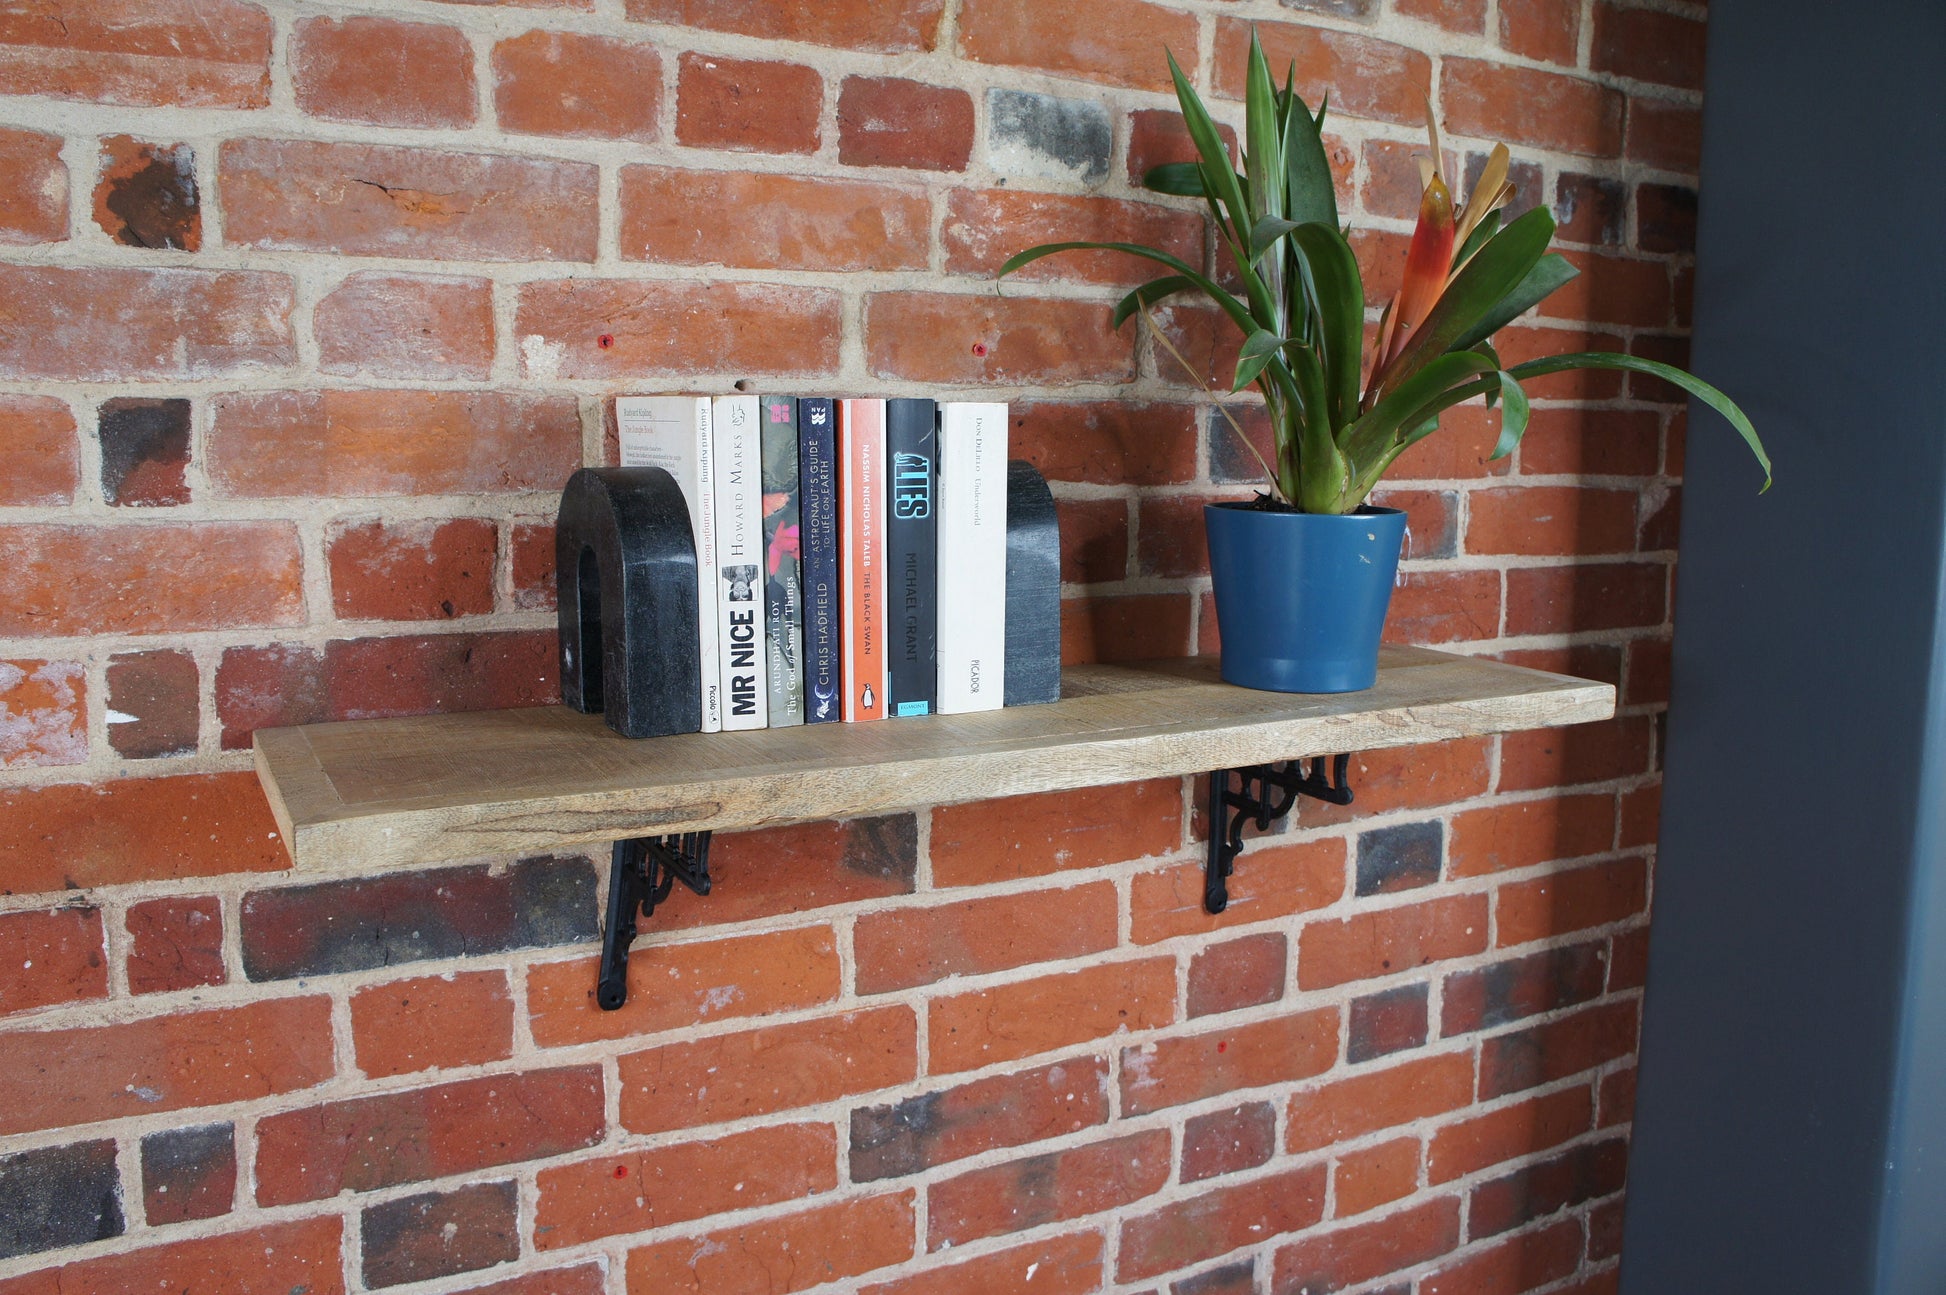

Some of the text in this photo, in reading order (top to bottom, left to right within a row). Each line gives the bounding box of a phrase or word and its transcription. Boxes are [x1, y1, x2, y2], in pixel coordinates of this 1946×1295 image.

[703, 511, 712, 542] Jungle
[809, 440, 820, 569] AN ASTRONAUT'S GUIDE
[820, 460, 830, 548] TO LIFE ON EARTH
[862, 444, 871, 567] NASSIM NICHOLAS TALEB
[895, 464, 929, 519] LIES
[705, 544, 713, 567] Book
[772, 600, 782, 694] ARUNDHATI ROY
[784, 576, 797, 716] The God of Small Things
[817, 583, 829, 686] CHRIS HADFIELD
[863, 573, 871, 655] THE BLACK SWAN
[905, 553, 918, 663] MICHAEL GRANT
[709, 685, 717, 710] Piccolo
[729, 609, 756, 716] MR NICE
[970, 659, 980, 694] PICADOR
